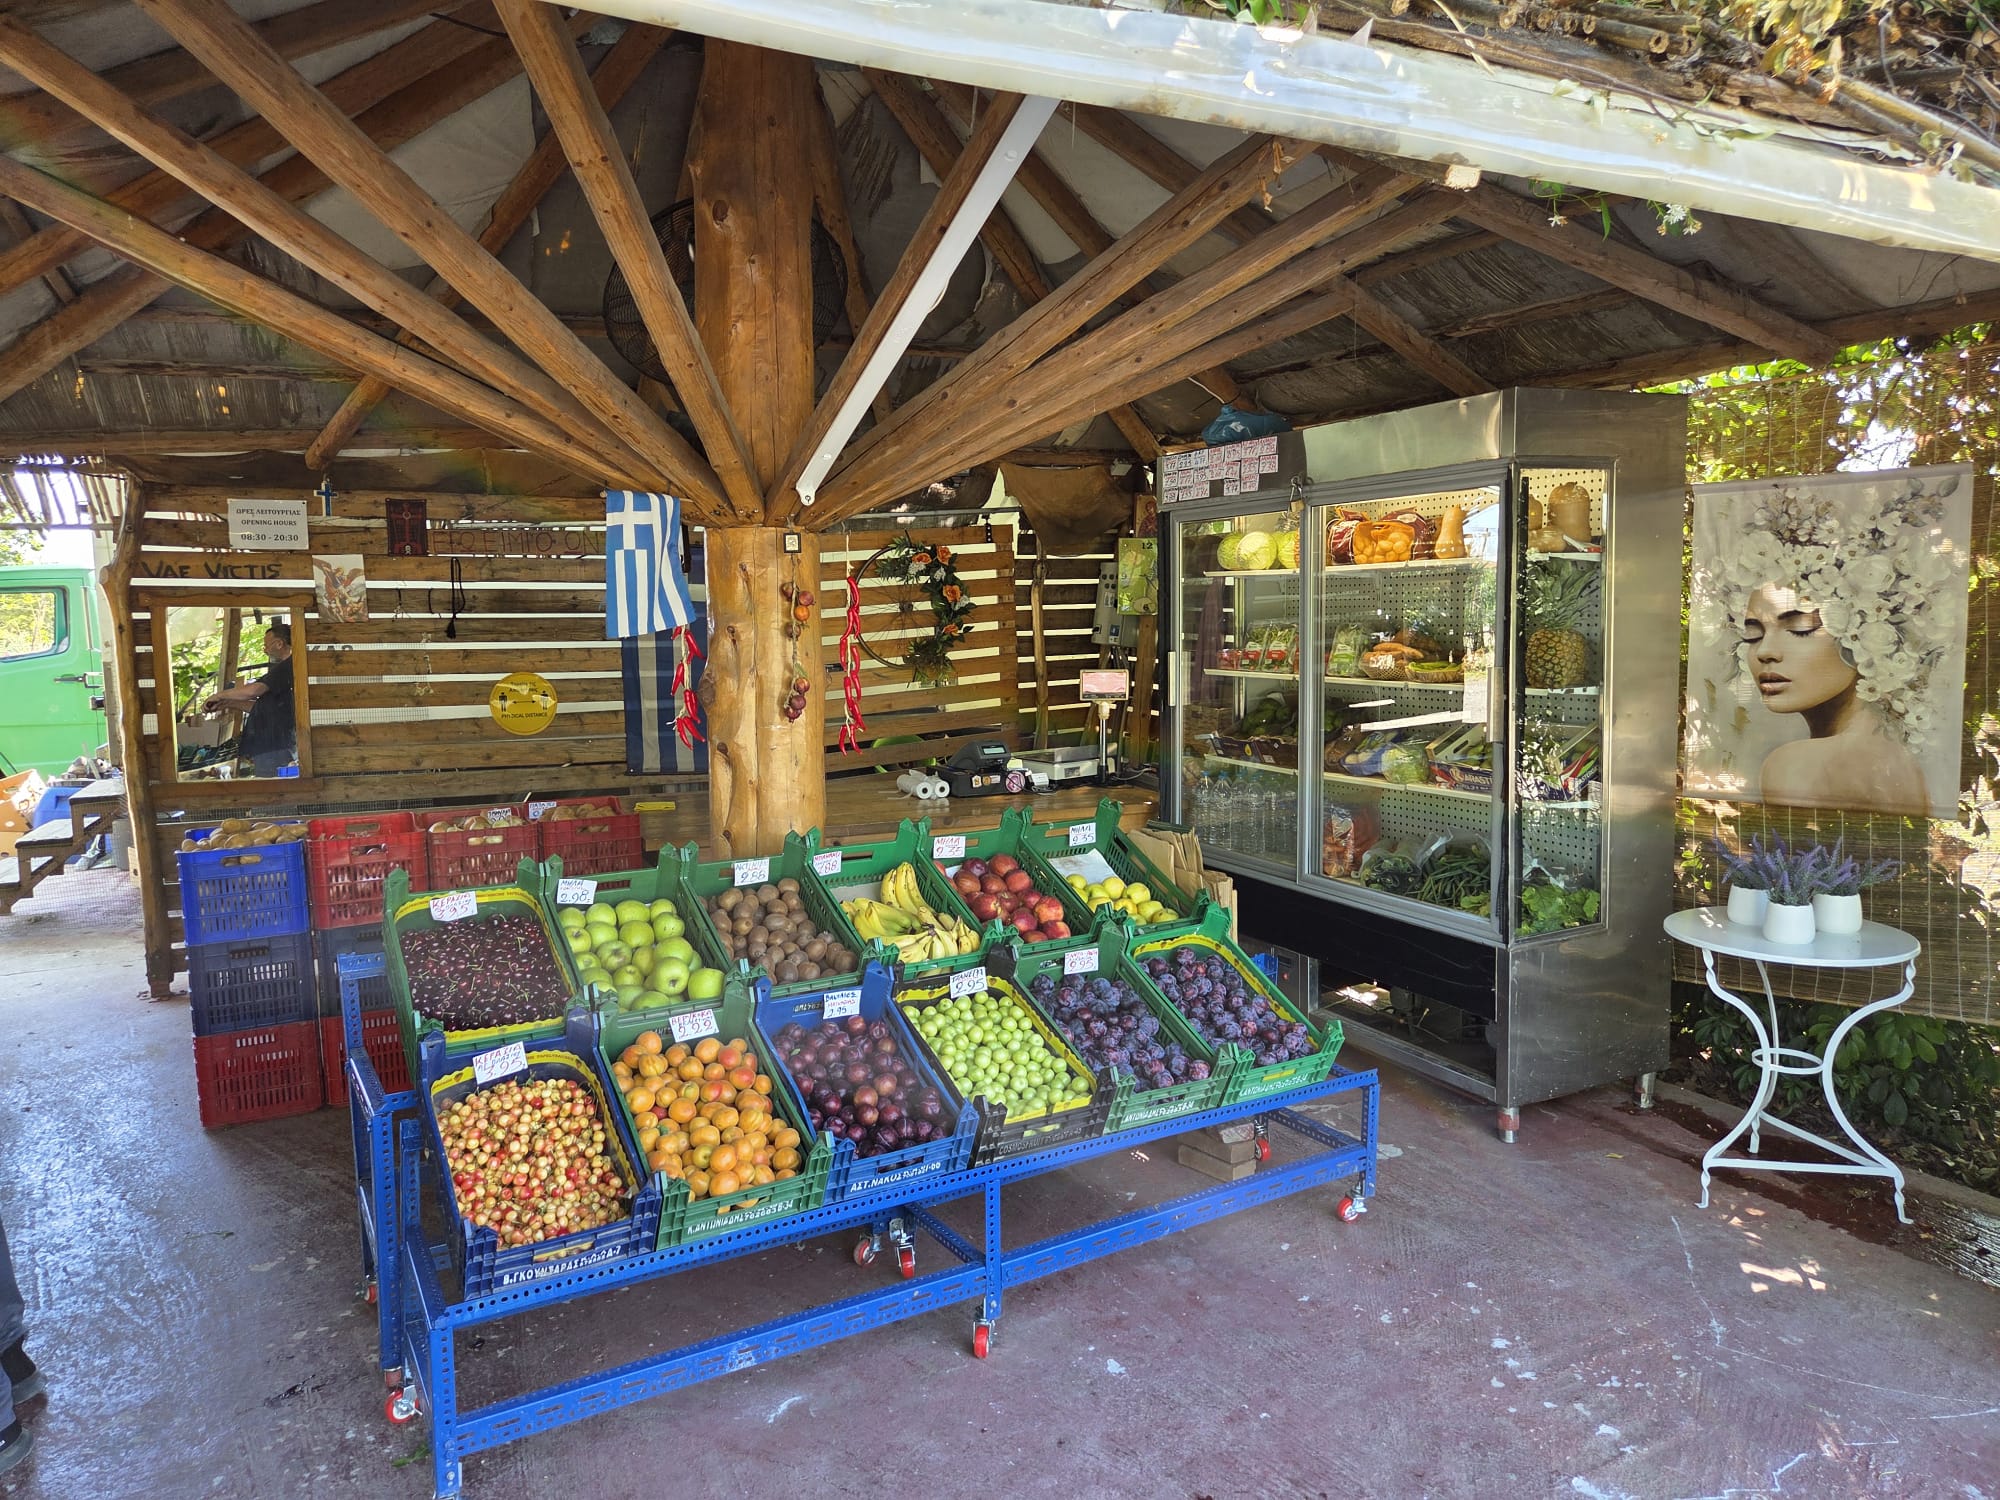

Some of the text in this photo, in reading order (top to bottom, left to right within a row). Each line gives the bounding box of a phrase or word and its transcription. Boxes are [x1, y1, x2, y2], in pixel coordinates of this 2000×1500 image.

[256, 508, 301, 516] ΛΕΙΤΟΥΡΓΙΑΣ
[241, 533, 267, 541] 08:30
[273, 534, 299, 542] 20:30
[1142, 542, 1153, 550] 12
[203, 561, 283, 580] VICTIS
